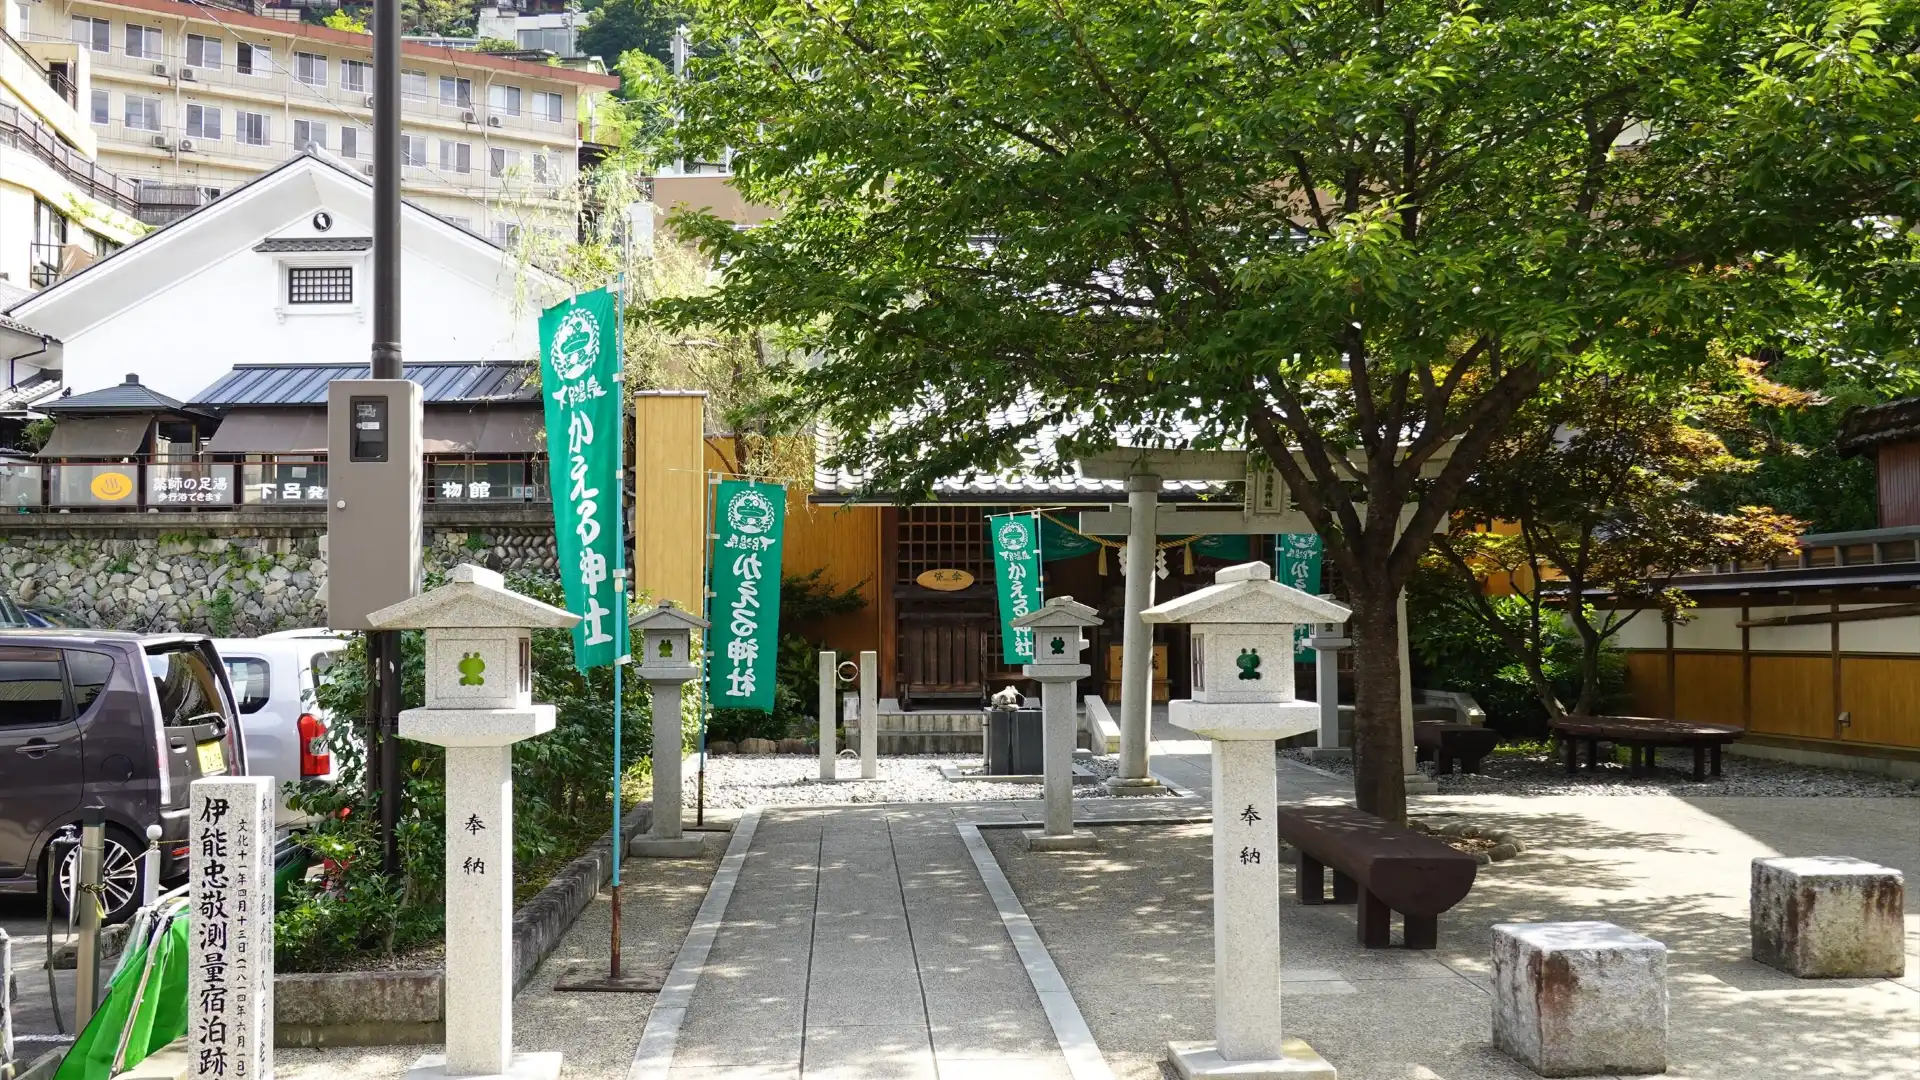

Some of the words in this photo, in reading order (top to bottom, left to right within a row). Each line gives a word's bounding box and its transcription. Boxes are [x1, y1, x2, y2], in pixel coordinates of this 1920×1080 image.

[552, 374, 607, 411] 下呂温泉
[153, 476, 228, 491] 薬師の足湯
[568, 410, 613, 646] かえる神社
[463, 813, 486, 875] 奉納
[1240, 804, 1262, 865] 奉納
[198, 796, 230, 1080] 伊能忠敬測量宿泊跡
